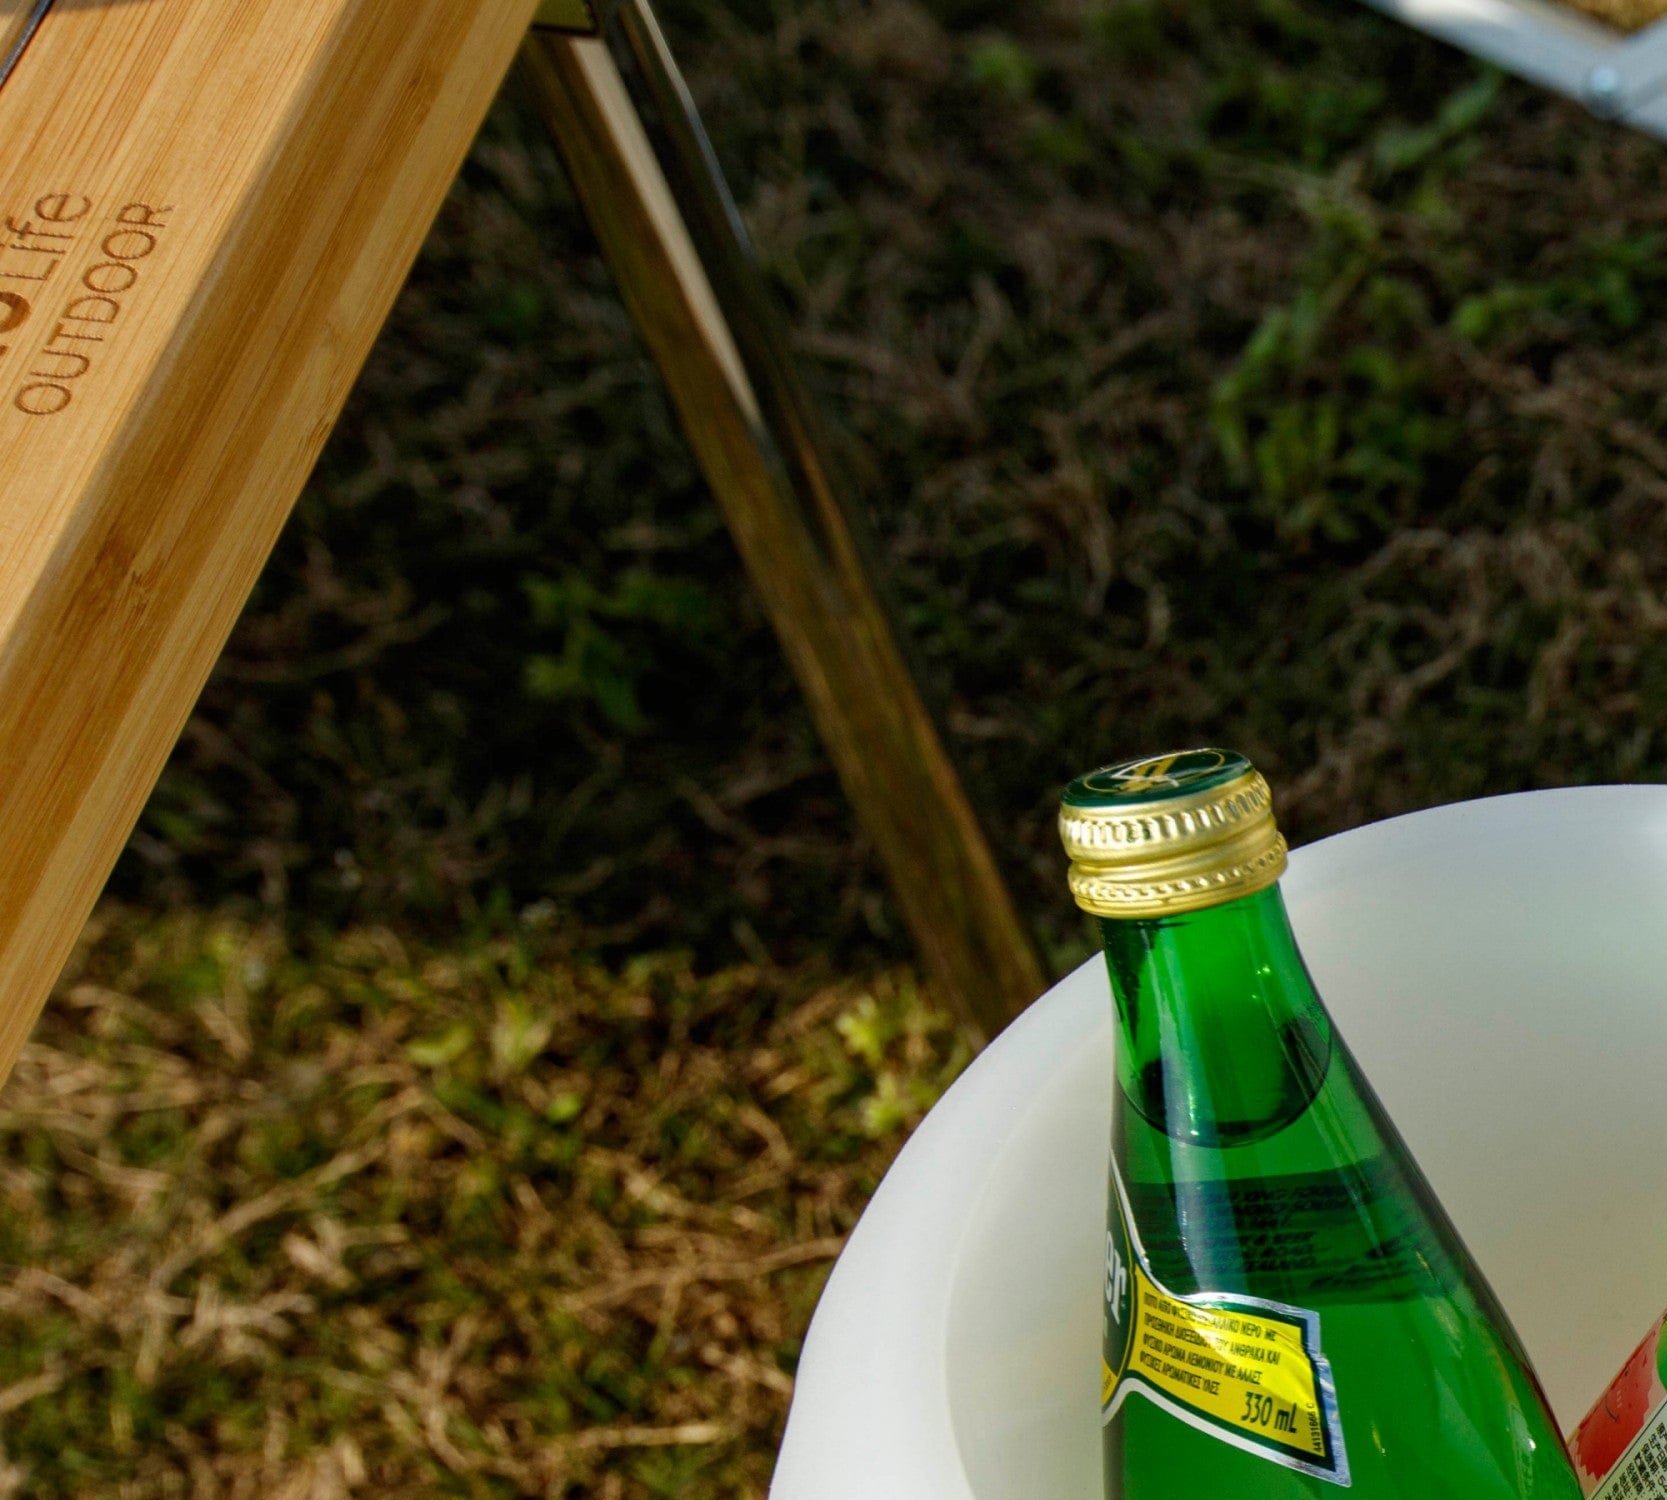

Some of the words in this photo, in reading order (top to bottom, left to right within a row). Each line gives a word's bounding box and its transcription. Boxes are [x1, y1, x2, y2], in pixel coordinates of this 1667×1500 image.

[14, 201, 175, 415] OUTDOOR
[1241, 1391, 1273, 1427] 330
[1273, 1402, 1298, 1434] mL
